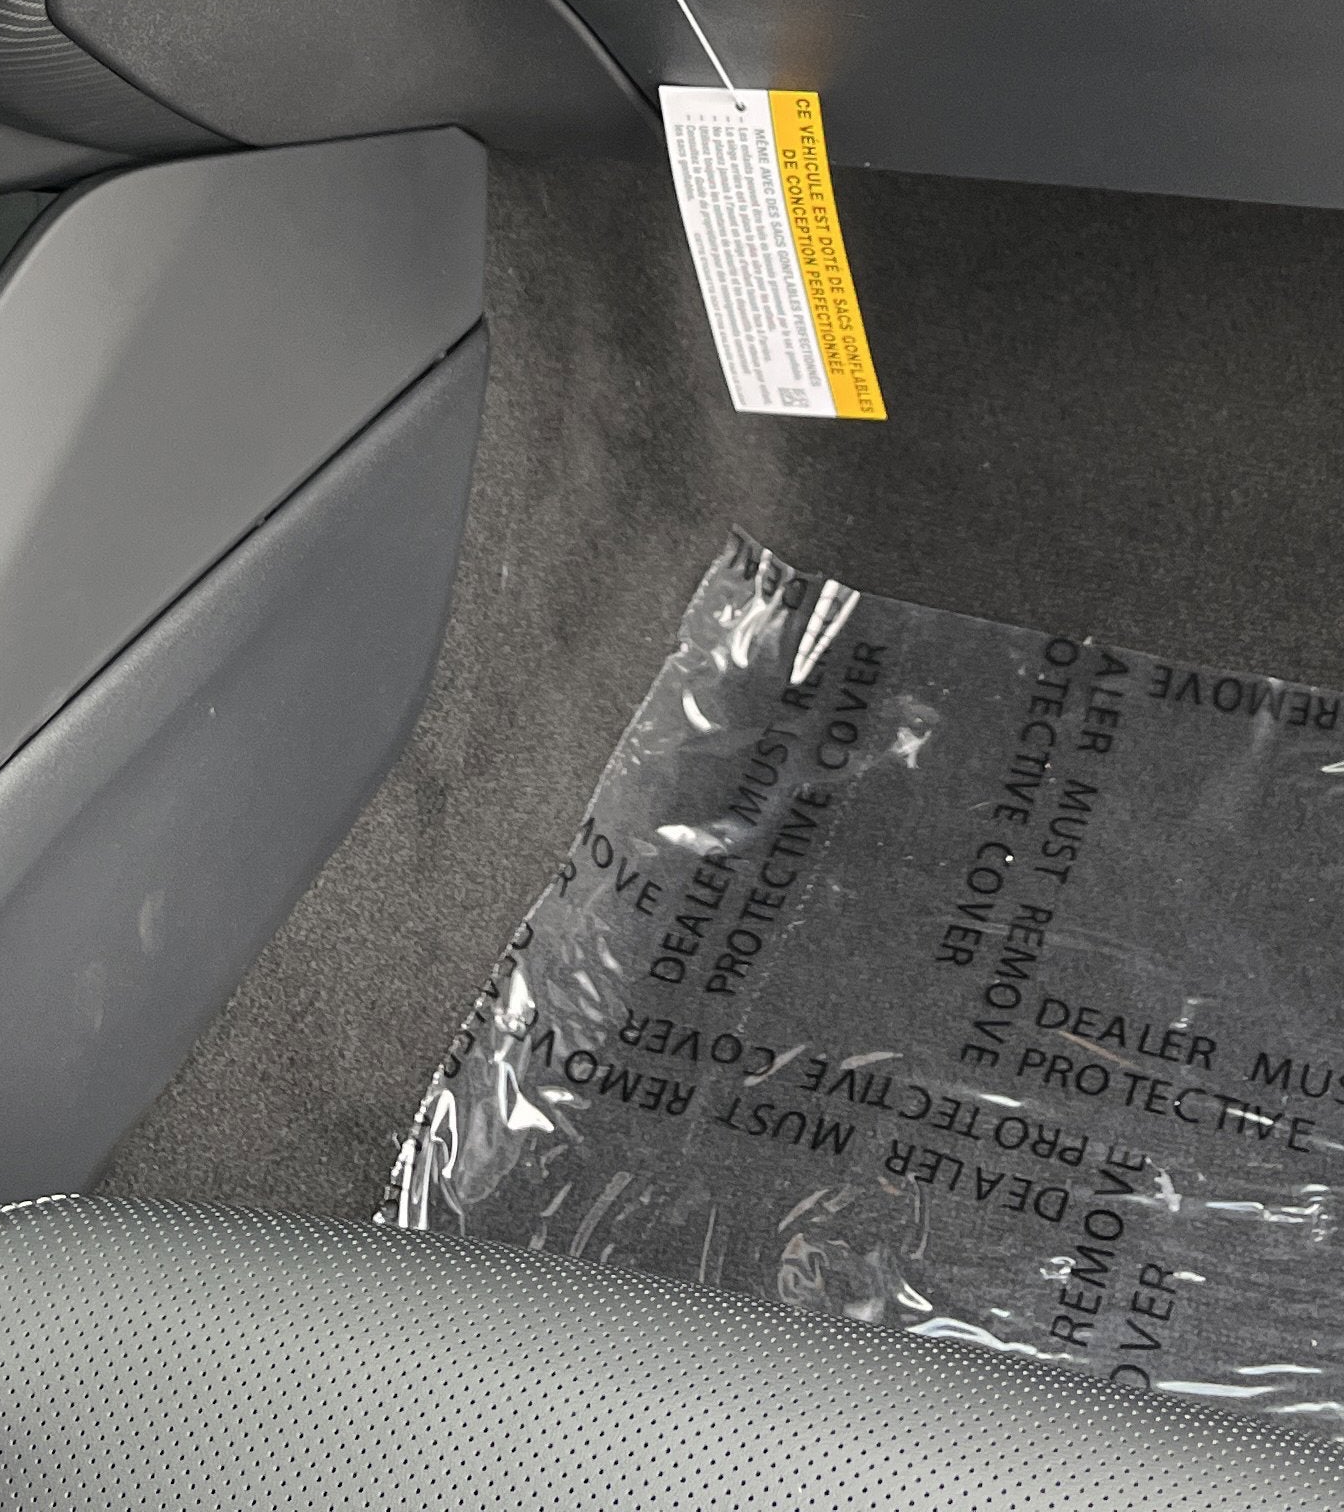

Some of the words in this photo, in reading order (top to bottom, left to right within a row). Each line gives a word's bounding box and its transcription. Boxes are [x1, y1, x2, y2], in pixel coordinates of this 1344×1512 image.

[793, 97, 814, 121] CE
[758, 166, 776, 196] AVEC
[779, 148, 799, 170] DE
[794, 124, 832, 201] VÉHICULE
[764, 197, 780, 218] DES
[769, 220, 787, 248] SACS
[783, 174, 819, 266] CONCEPTION
[811, 205, 831, 232] EST
[827, 275, 845, 294] DE
[832, 297, 855, 331] SACS
[840, 334, 875, 413] GONFLABLES
[1149, 664, 1341, 731] REMOVE
[729, 724, 800, 826] MUST
[706, 779, 835, 996] PROTECTIVE
[816, 640, 888, 771] COVER
[1034, 778, 1098, 884] MUST
[935, 841, 1013, 969] COVER
[960, 903, 1054, 1068] REMOVE
[617, 1007, 778, 1079] COVER
[1035, 997, 1219, 1070] DEALER
[715, 1097, 856, 1156] MUST
[806, 1055, 1089, 1167] PROTECTIVE
[1017, 1046, 1316, 1153] PROTECTIVE
[884, 1138, 1070, 1224] DEALER
[1051, 1145, 1147, 1348] REMOVE
